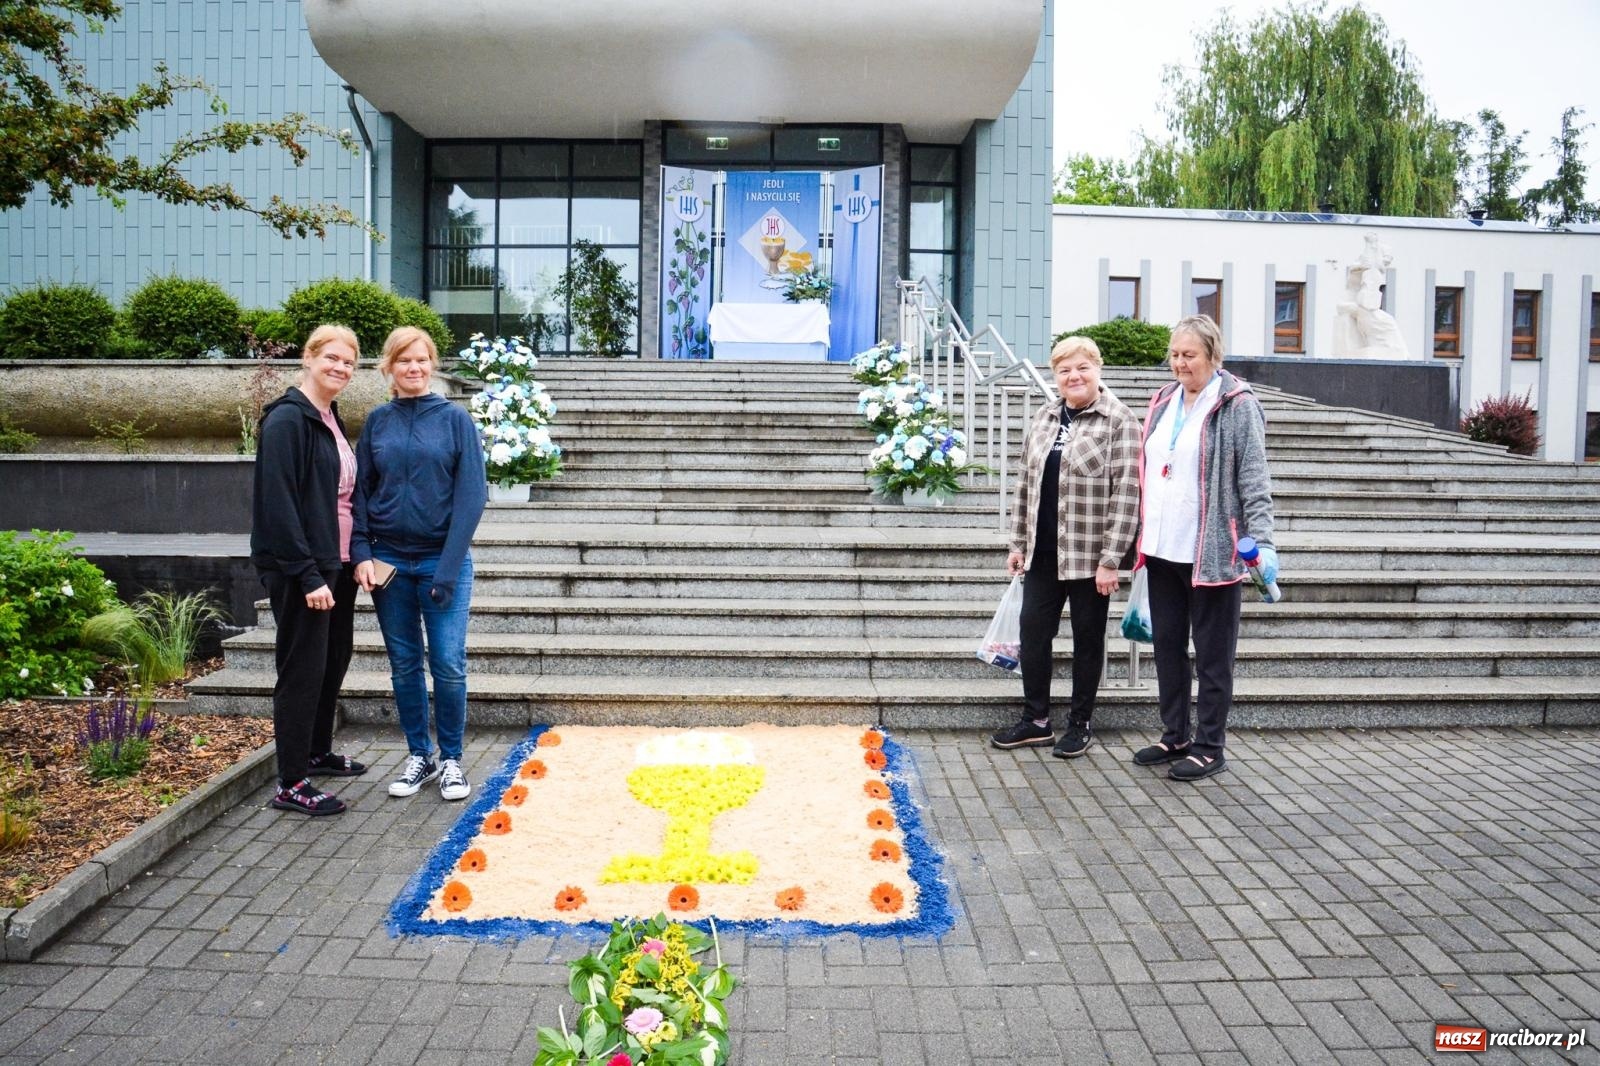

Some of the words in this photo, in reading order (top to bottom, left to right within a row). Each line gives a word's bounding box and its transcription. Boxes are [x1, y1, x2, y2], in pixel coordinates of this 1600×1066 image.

[762, 179, 785, 189] JEDLI
[751, 192, 787, 201] NASYCILI
[787, 192, 801, 204] SIĘ
